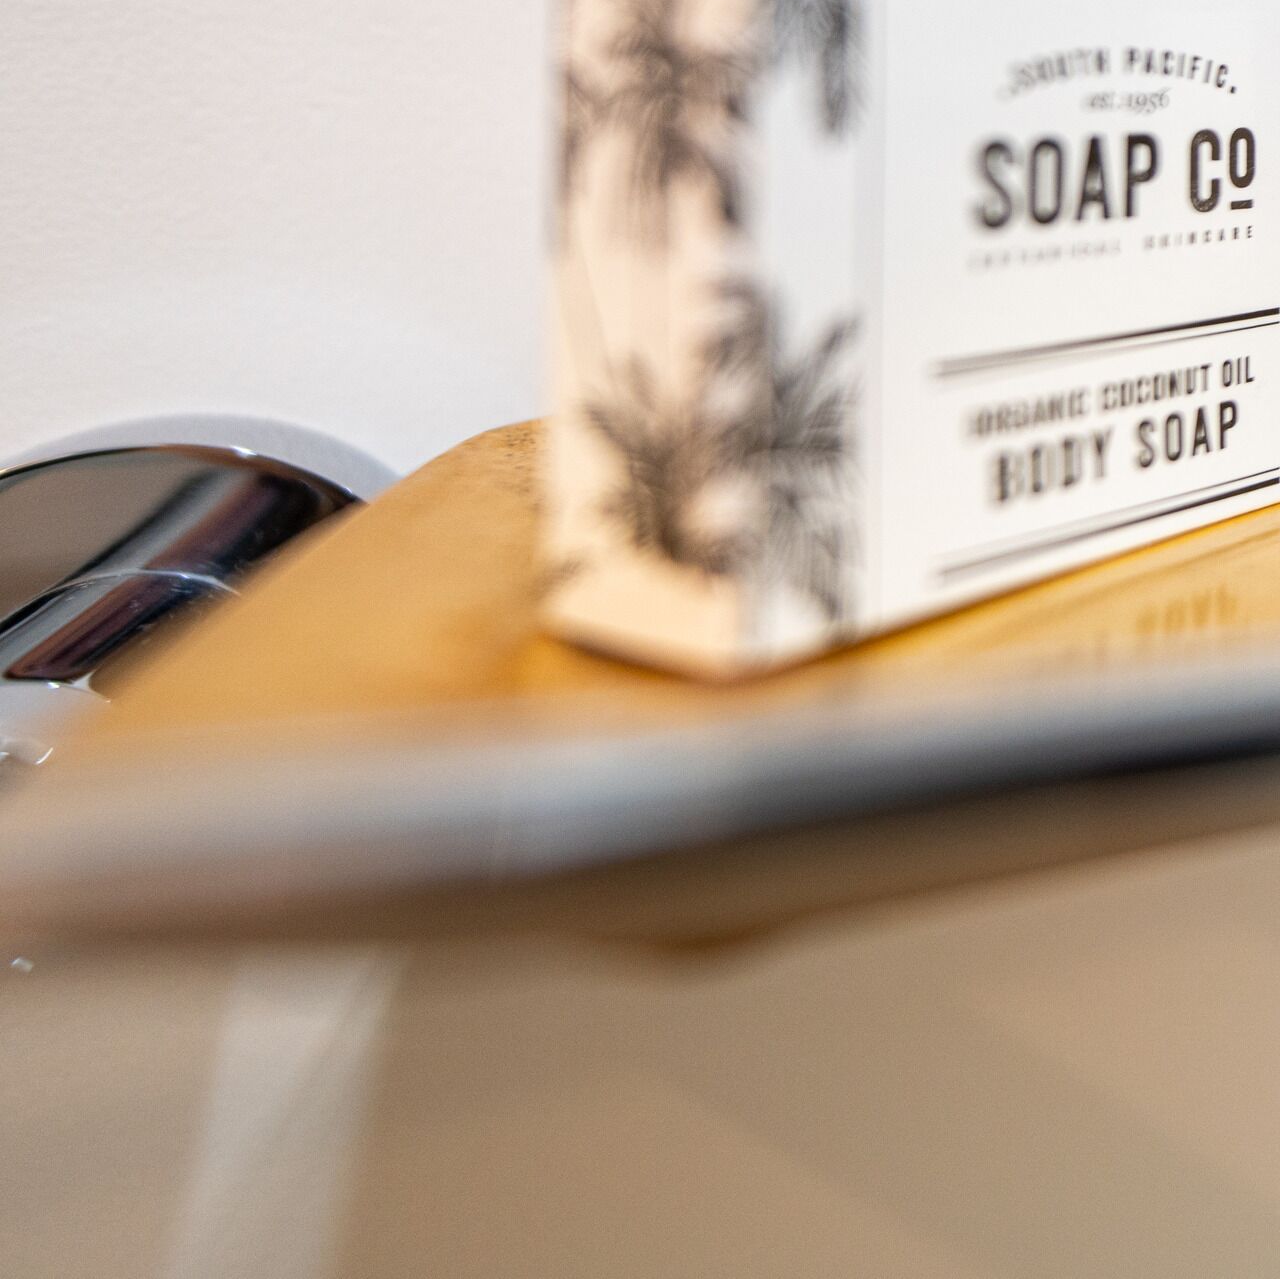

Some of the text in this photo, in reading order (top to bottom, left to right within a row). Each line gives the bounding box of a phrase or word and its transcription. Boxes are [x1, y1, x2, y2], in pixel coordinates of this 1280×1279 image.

[975, 131, 1162, 231] SOAP
[1100, 363, 1211, 412] COCONUT
[1221, 355, 1256, 388] OIL
[992, 400, 1238, 503] BODY SOAP
